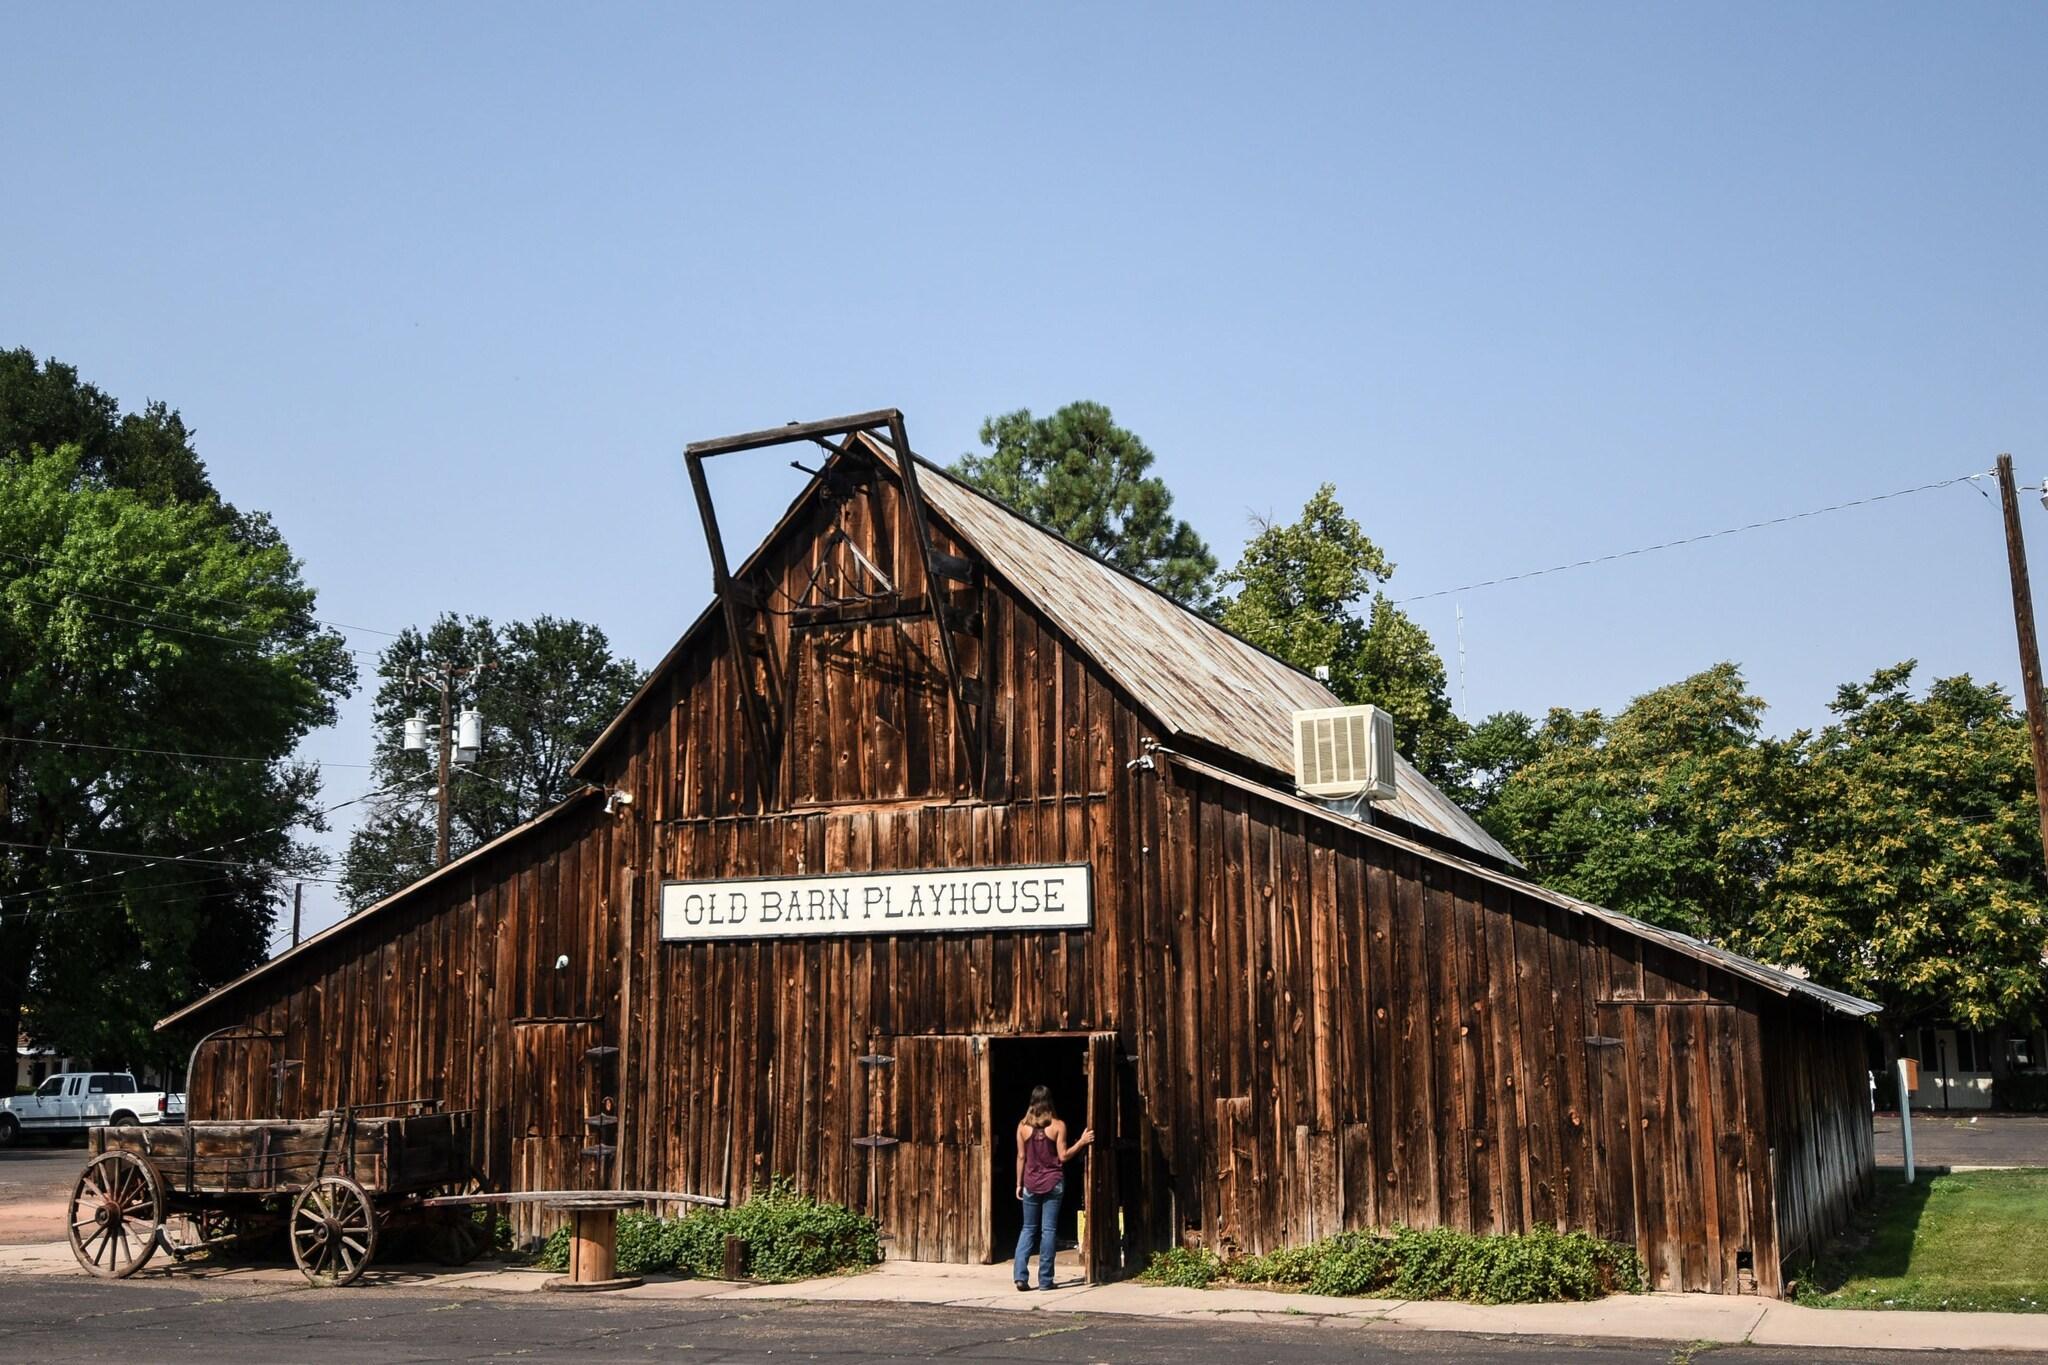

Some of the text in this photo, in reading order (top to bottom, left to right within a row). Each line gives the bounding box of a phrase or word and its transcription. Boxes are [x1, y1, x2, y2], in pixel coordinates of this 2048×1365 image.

[685, 879, 1064, 925] OLD BARN PLAYHOUSE
